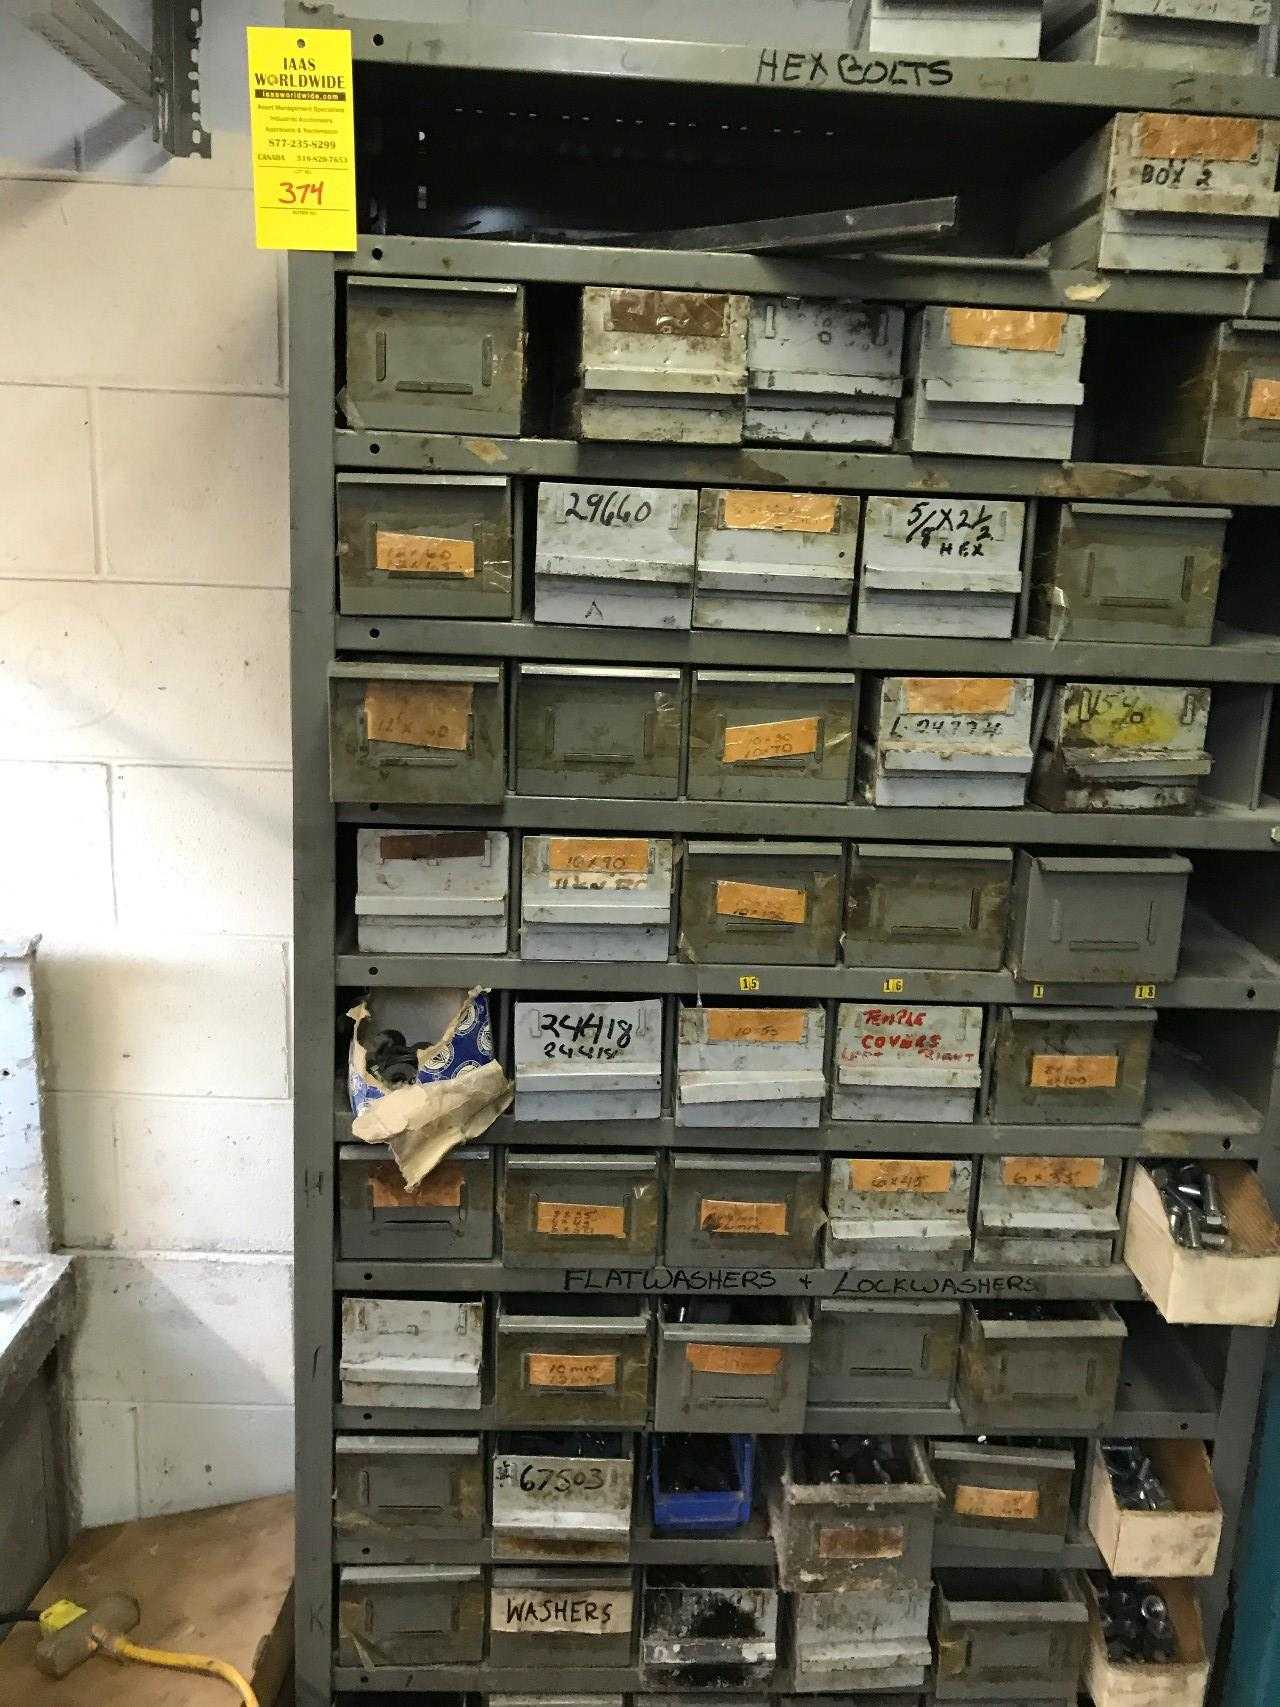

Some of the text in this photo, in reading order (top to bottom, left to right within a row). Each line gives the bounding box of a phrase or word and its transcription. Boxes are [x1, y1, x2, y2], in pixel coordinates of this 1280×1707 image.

[283, 57, 316, 71] IAAS
[757, 48, 953, 86] HEX BOLTS
[255, 73, 344, 89] WORLDWIDE
[278, 181, 324, 205] 374
[940, 541, 984, 557] HEX
[506, 1598, 613, 1624] WASHERS
